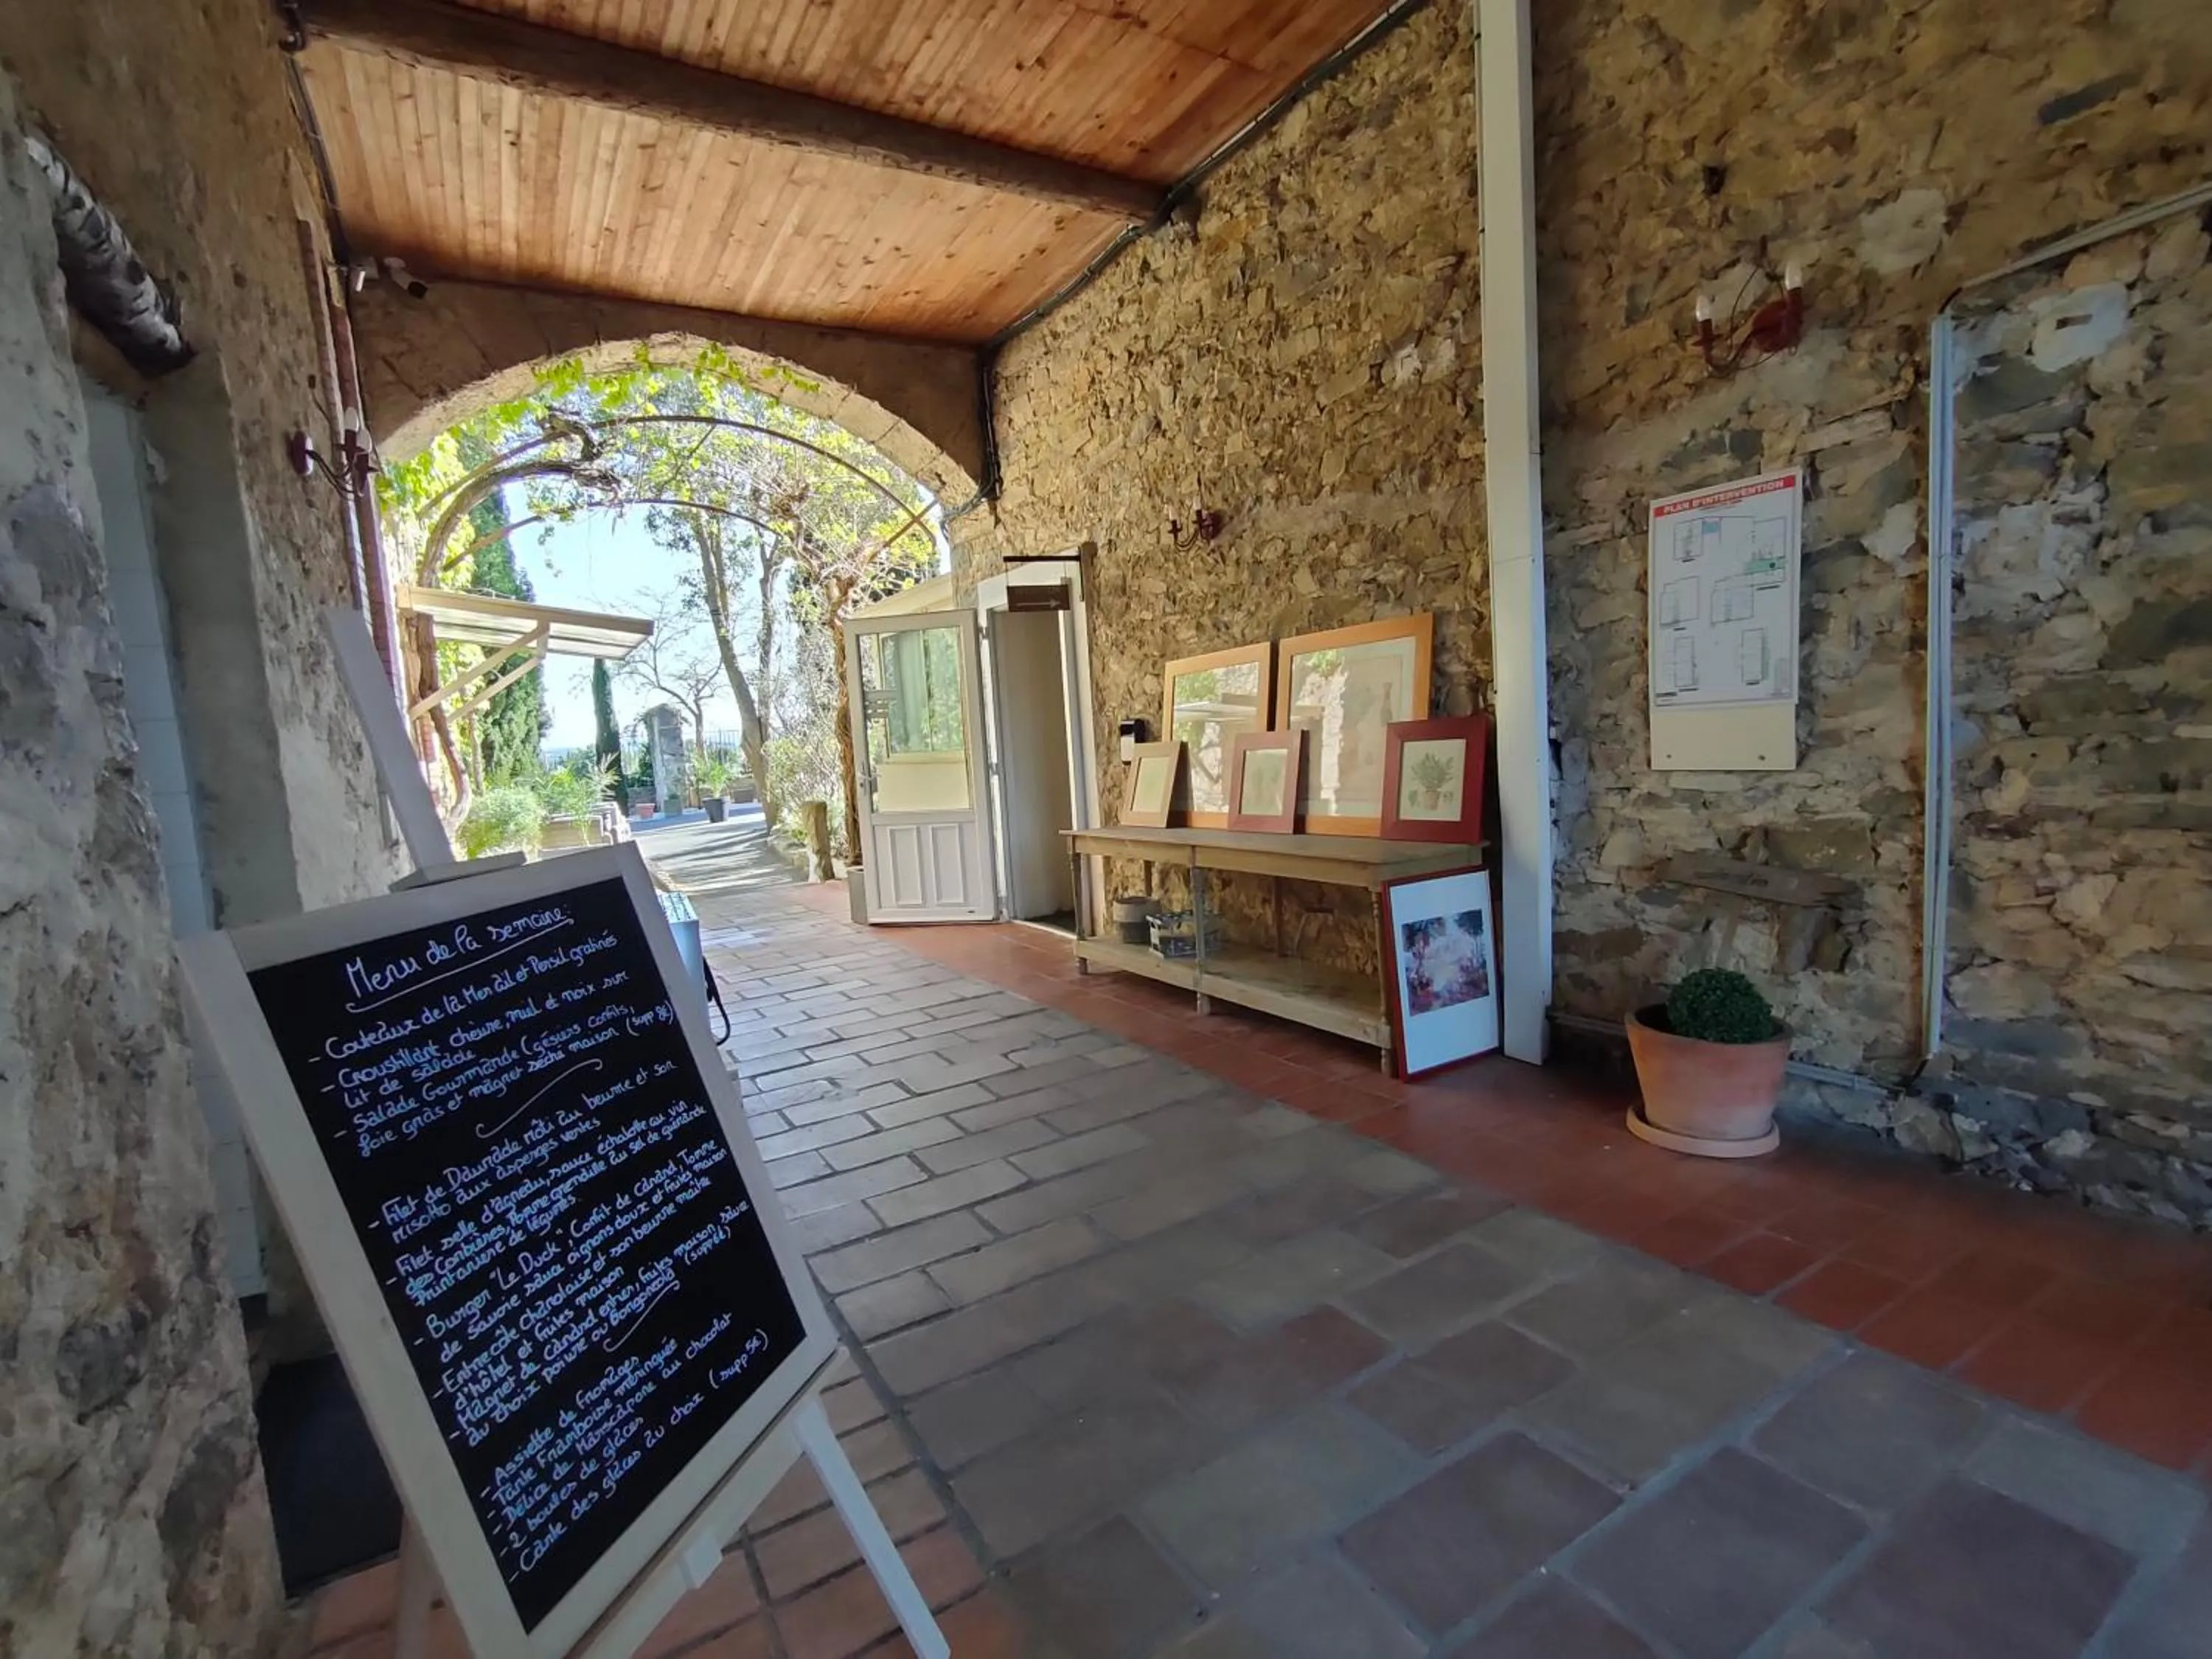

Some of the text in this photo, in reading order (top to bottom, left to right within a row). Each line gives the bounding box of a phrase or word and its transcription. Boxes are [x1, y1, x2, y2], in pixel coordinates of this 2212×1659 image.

[346, 956, 422, 998] Menu
[426, 940, 457, 964] de
[455, 925, 483, 953] la
[545, 993, 560, 1009] et
[562, 981, 596, 1003] noix
[602, 970, 629, 989] sur
[325, 1019, 421, 1059] Couteaux
[421, 1006, 445, 1025] de
[443, 995, 466, 1015] la
[515, 965, 529, 982] et
[353, 1095, 420, 1133] Salade
[358, 1130, 398, 1158] foie
[403, 1105, 445, 1141] gras
[448, 1093, 463, 1110] et
[568, 1027, 619, 1052] maison
[379, 1078, 403, 1096] de
[381, 1195, 419, 1225] Filet
[424, 1184, 447, 1204] de
[556, 1110, 582, 1126] au
[582, 1079, 636, 1109] beurre
[636, 1067, 649, 1085] et
[653, 1060, 679, 1077] son
[608, 1150, 629, 1166] au
[646, 1131, 661, 1144] de
[395, 1245, 434, 1277] Filet
[649, 1113, 666, 1127] au
[668, 1099, 689, 1116] vin
[456, 1180, 493, 1205] aux
[425, 1290, 492, 1339] Burger
[616, 1193, 632, 1209] de
[508, 1228, 527, 1247] de
[592, 1251, 608, 1273] et
[440, 1340, 462, 1363] de
[652, 1189, 664, 1204] et
[518, 1339, 534, 1359] et
[575, 1266, 625, 1307] maison
[591, 1322, 608, 1342] ou
[520, 1362, 542, 1380] de
[552, 1461, 574, 1481] de
[662, 1360, 682, 1379] au
[685, 1312, 732, 1360] chocolat
[495, 1427, 554, 1487] Assiette
[559, 1409, 577, 1428] de
[580, 1458, 600, 1480] de
[520, 1522, 568, 1571] Carte
[571, 1492, 599, 1520] des
[644, 1425, 665, 1448] au
